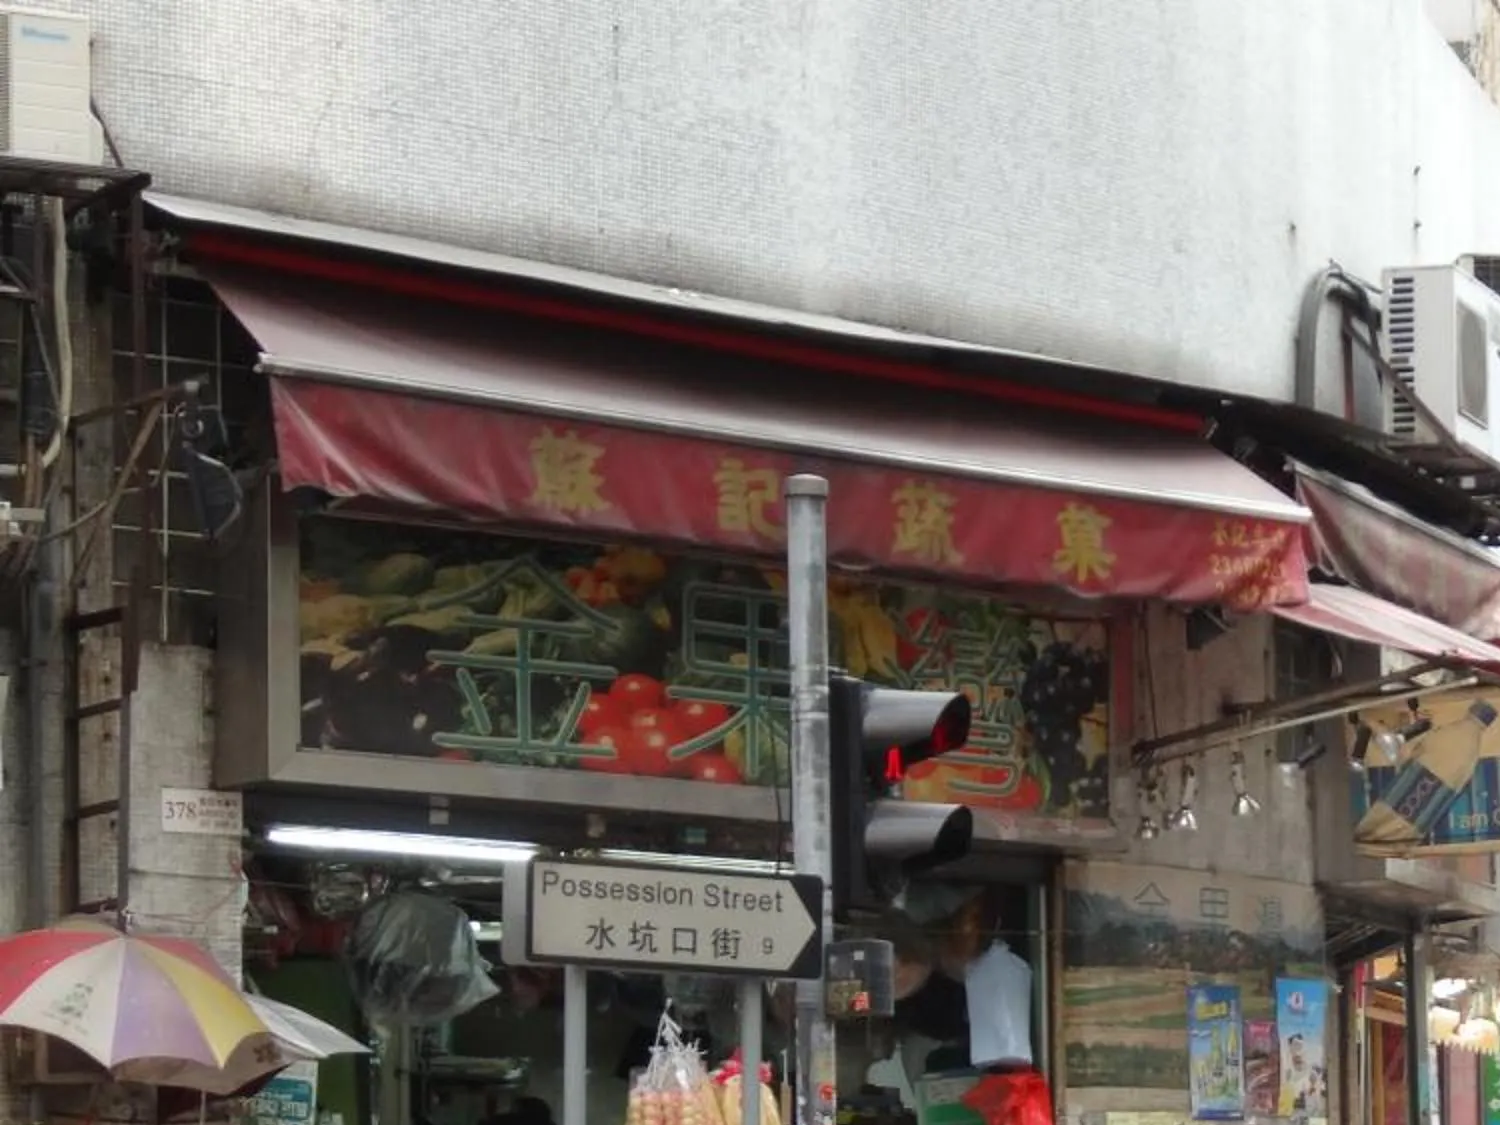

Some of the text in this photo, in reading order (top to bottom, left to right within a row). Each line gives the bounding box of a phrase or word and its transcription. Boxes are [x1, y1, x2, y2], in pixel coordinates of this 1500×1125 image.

[164, 800, 198, 819] 378
[541, 869, 783, 914] Possession Street
[585, 917, 742, 960] 水坑口街
[762, 936, 775, 955] 9
